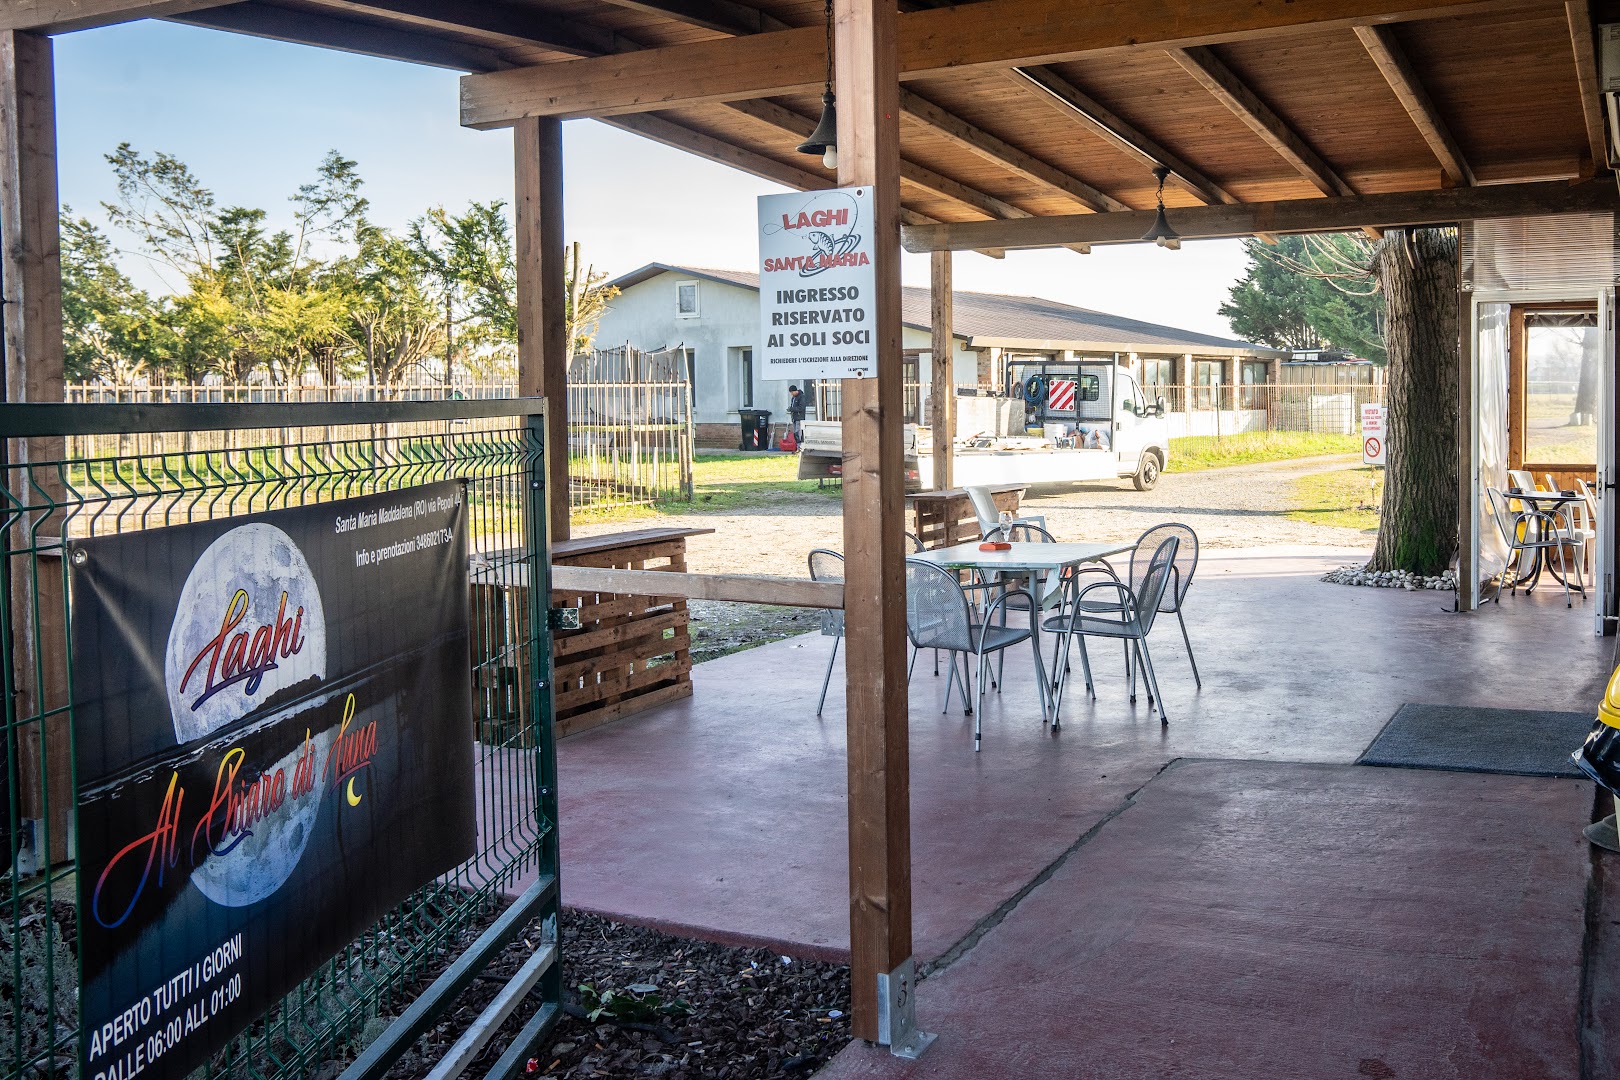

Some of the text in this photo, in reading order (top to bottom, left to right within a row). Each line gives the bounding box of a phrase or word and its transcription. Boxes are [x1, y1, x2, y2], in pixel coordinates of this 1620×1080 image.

[782, 208, 849, 230] LAGHI
[764, 251, 870, 272] SANTA MARIA
[776, 286, 859, 304] INGRESSO
[772, 308, 865, 326] RISERVATO
[767, 330, 870, 348] AI SOLI SOCI
[798, 356, 829, 364] L'ISCRIZIONE
[335, 516, 357, 534] Santa
[357, 510, 377, 529] Maria
[378, 503, 413, 524] Maddalena
[413, 499, 427, 520] (RO)
[427, 500, 437, 513] via
[437, 493, 454, 514] Pepoli
[355, 548, 370, 568] Info
[370, 553, 376, 564] e
[376, 537, 416, 566] prenotazioni
[179, 588, 306, 712] Laghi
[92, 692, 379, 929] Al Chiaro di Luna
[89, 932, 242, 1062] APERTO TUTTI I GIORNI
[147, 1016, 182, 1064] 06:00
[184, 998, 209, 1037] ALL
[210, 972, 241, 1016] 01:00
